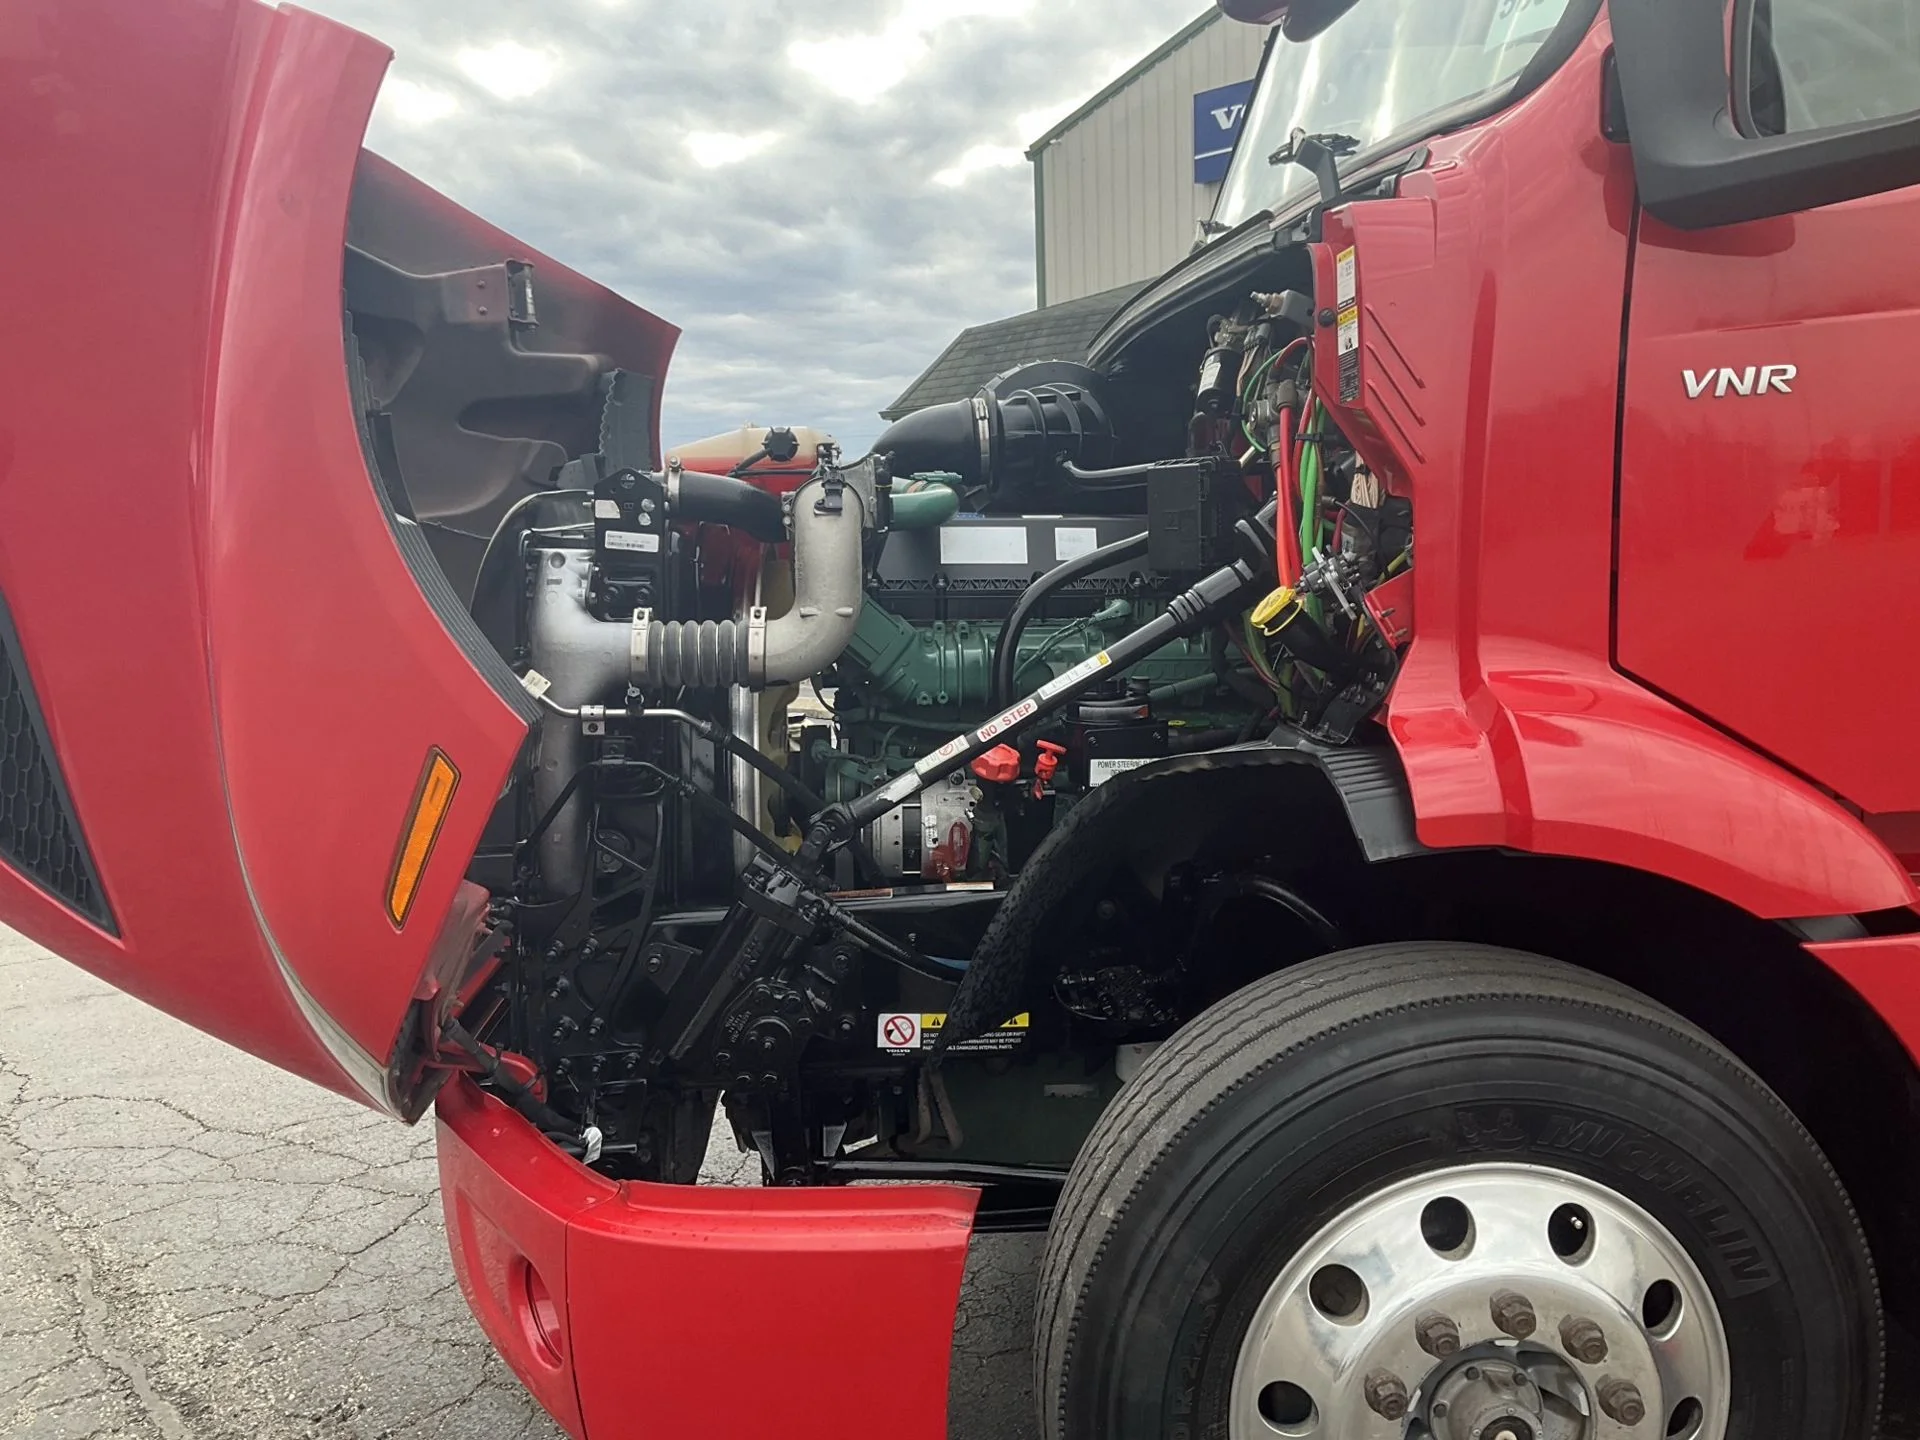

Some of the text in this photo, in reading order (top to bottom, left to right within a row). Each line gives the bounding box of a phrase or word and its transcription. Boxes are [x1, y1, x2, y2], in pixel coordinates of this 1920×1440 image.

[1682, 364, 1797, 399] VNR
[980, 703, 1032, 740] NO STEP
[1097, 761, 1116, 769] POWER
[1536, 1112, 1772, 1288] MICHELIN
